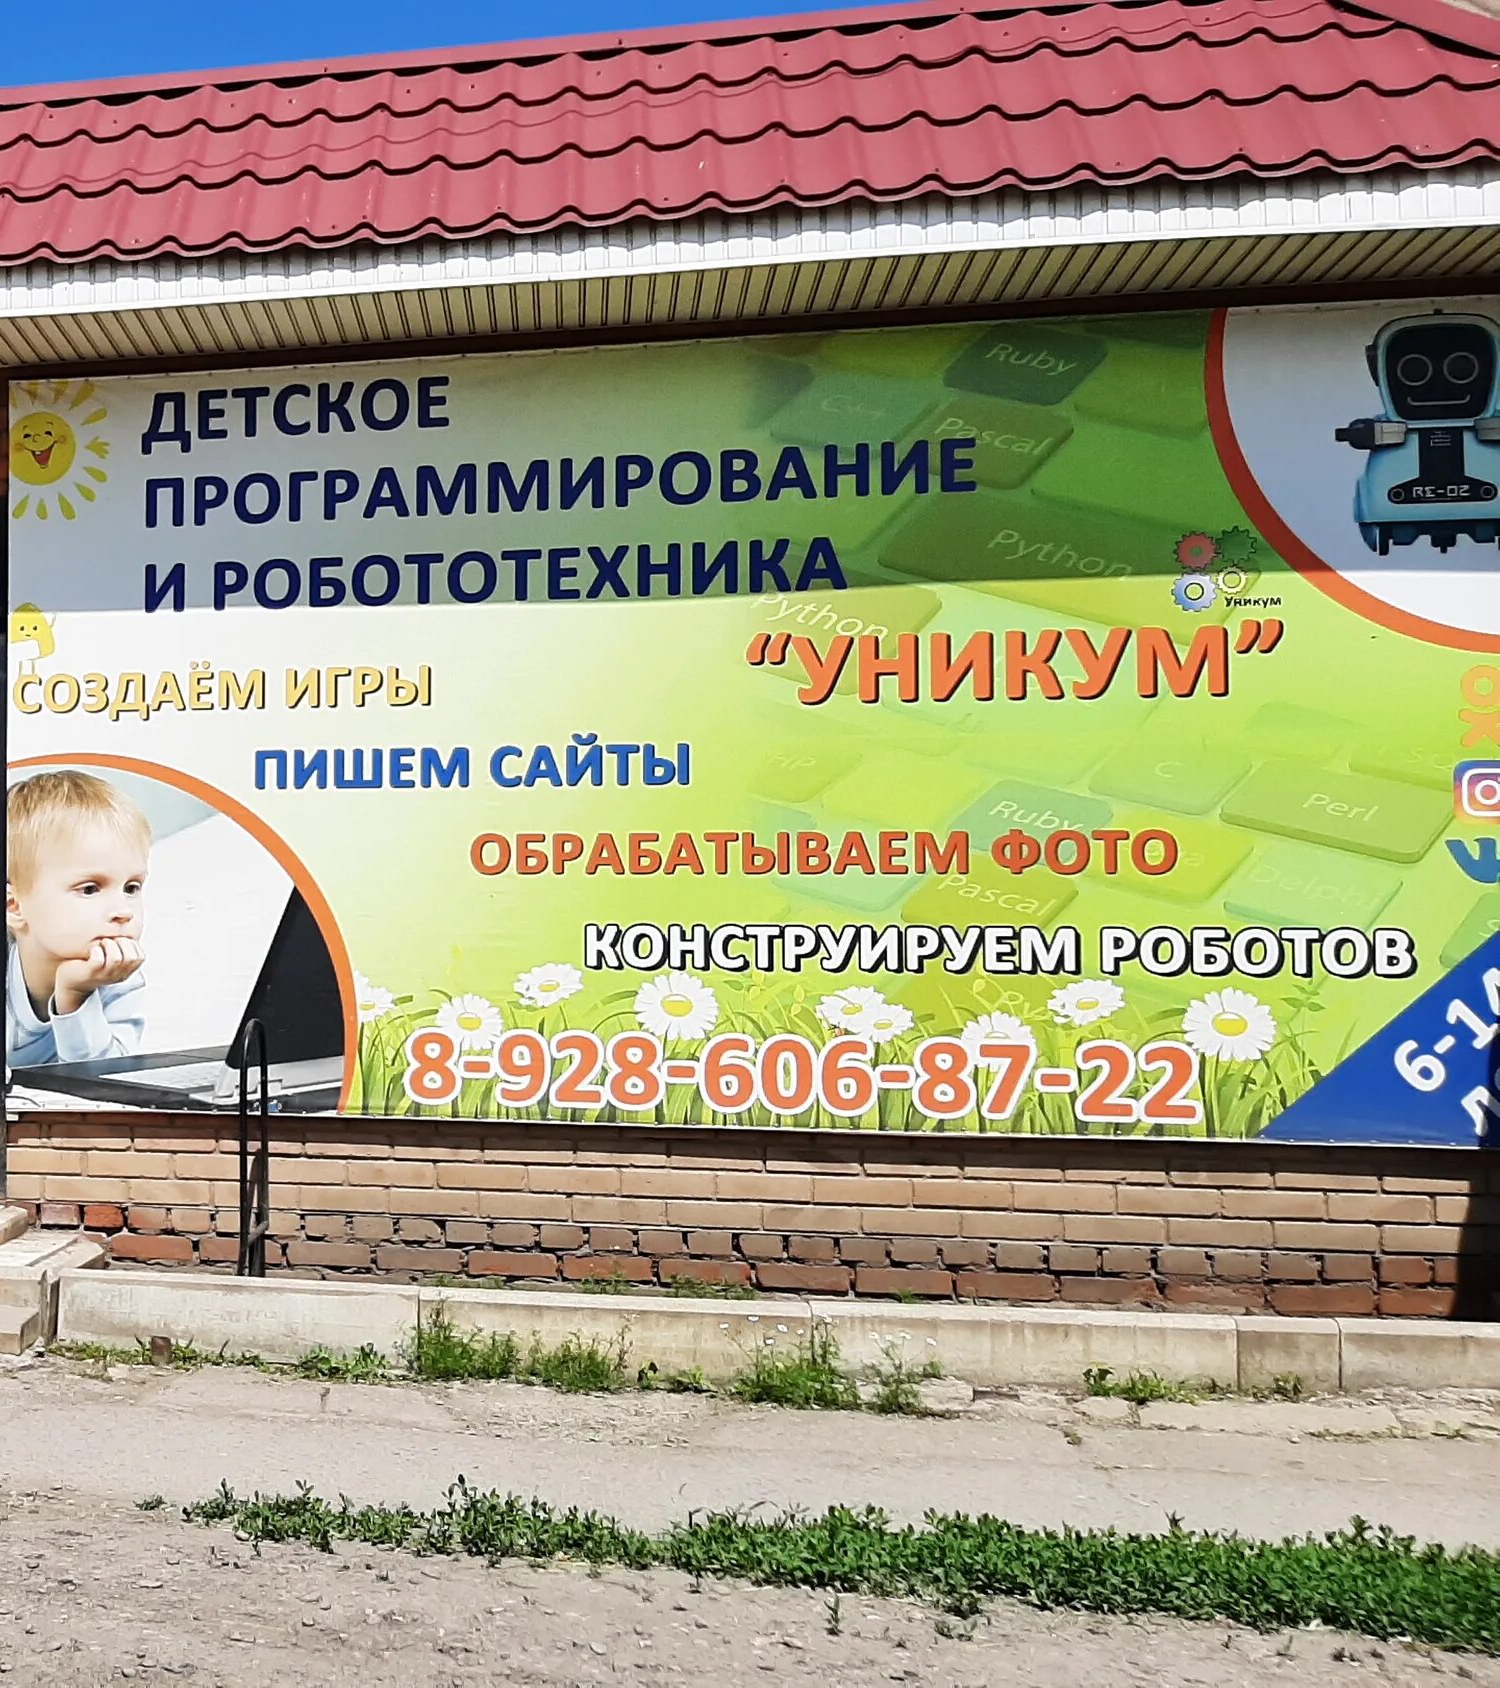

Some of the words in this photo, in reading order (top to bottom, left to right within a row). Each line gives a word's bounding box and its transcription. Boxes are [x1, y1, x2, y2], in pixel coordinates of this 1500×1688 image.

[985, 343, 1077, 376] Ruby
[141, 376, 450, 456] ДЕТСКОЕ
[934, 417, 1054, 456] Pascal
[144, 437, 977, 528] ПРОГРАММИРОВАНИЕ
[1412, 485, 1471, 498] RE-02
[144, 562, 186, 613] И
[213, 536, 848, 611] РОБОТОТЕХНИКА
[987, 529, 1133, 580] Python
[750, 592, 889, 640] Python
[1224, 594, 1282, 608] Уникум
[12, 659, 266, 720] СОЗДАЁМ
[284, 664, 433, 709] ИГРЫ
[253, 743, 469, 789] ПИШЕМ
[489, 731, 691, 787] САЙТЫ
[988, 800, 1084, 831] Ruby
[1302, 793, 1379, 822] Perl
[470, 829, 970, 876] ОБРАБАТЫВАЕМ
[990, 828, 1179, 876] ФОТО
[937, 873, 1058, 917] Pascal
[583, 922, 1083, 976] КОНСТРУИРУЕМ
[1100, 925, 1418, 979] РОБОТОВ
[406, 1026, 1202, 1123] 8-928-606-87-22
